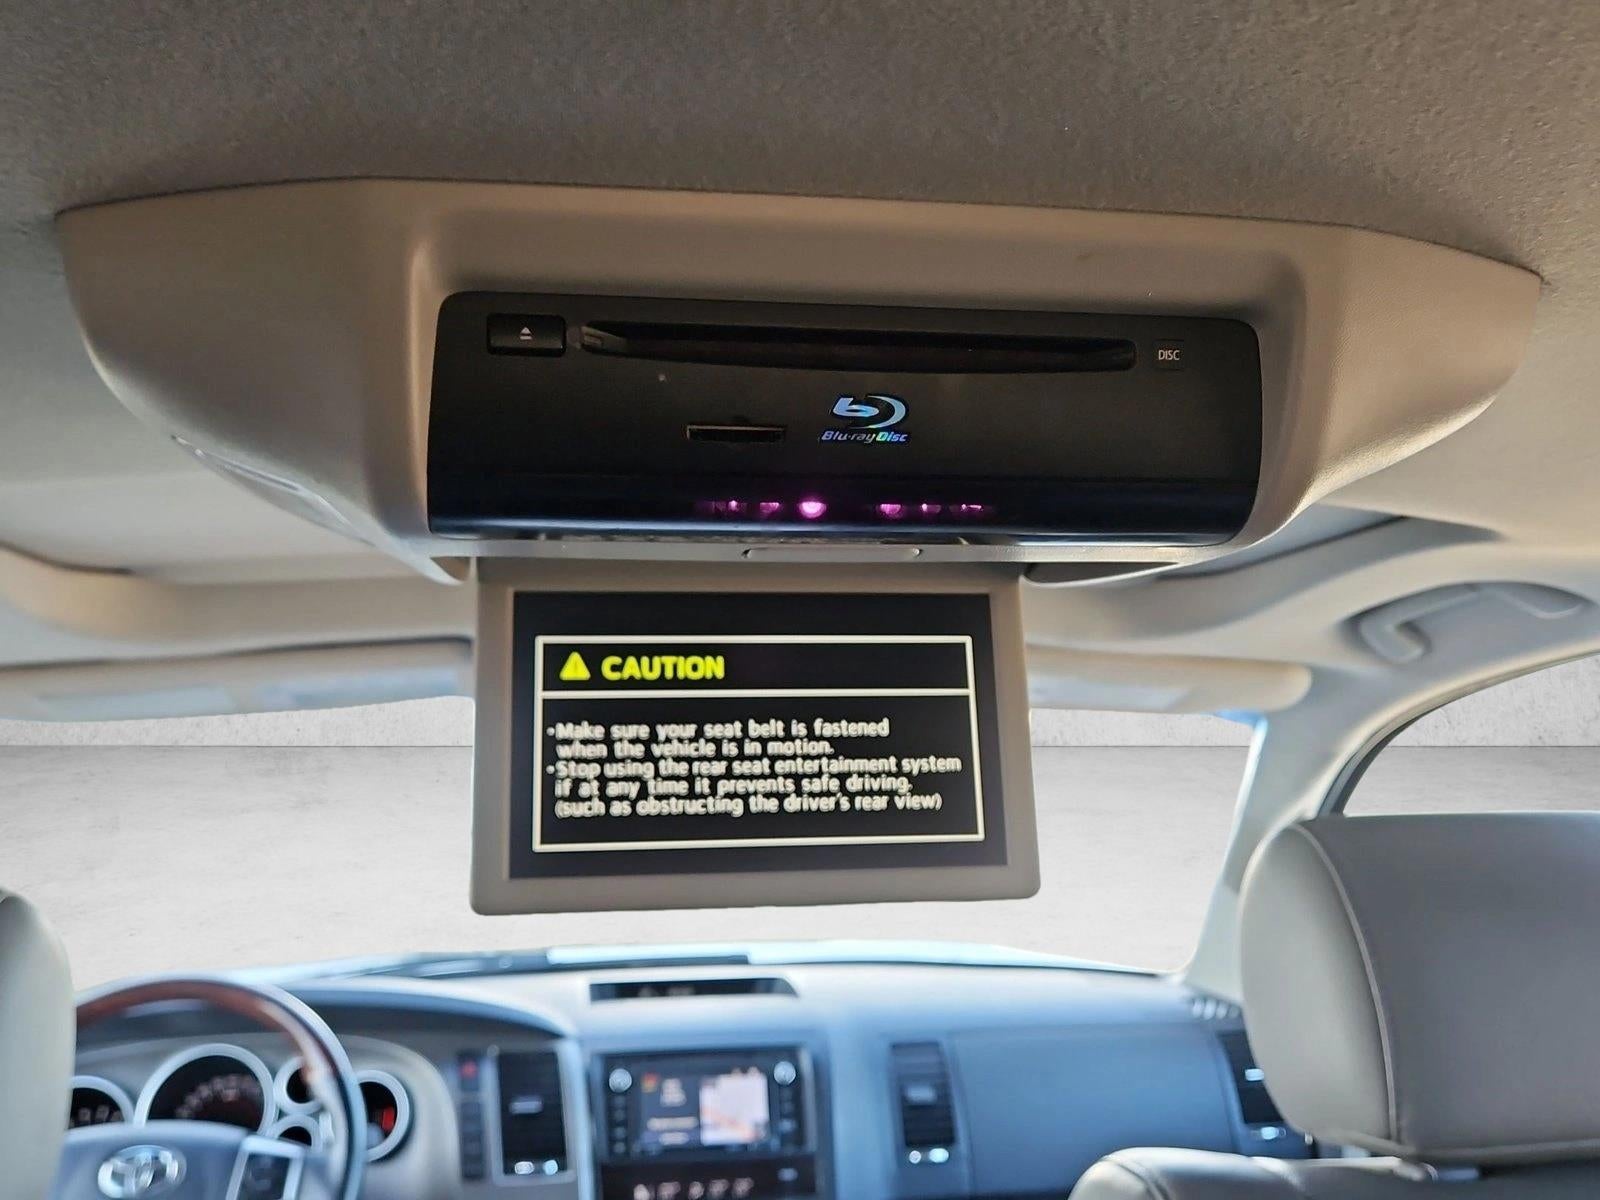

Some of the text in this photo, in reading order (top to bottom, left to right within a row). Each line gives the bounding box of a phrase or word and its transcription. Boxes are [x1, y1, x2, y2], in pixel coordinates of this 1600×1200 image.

[1158, 349, 1180, 361] DISC
[876, 431, 908, 442] Disc
[601, 655, 725, 681] CAUTION
[609, 723, 650, 741] sure
[655, 723, 698, 742] your
[703, 720, 743, 739] seat
[748, 717, 785, 738] belt
[791, 718, 808, 737] is
[813, 716, 890, 738] fastened
[555, 737, 835, 760] when the vehicle is in motion.
[603, 758, 655, 782] using
[658, 757, 690, 777] the
[692, 759, 729, 776] rear
[731, 757, 771, 776] seat
[774, 755, 899, 775] entertainment
[901, 755, 963, 777] system
[555, 773, 914, 801] if at any time it prevents safe driving.
[555, 792, 943, 820] (such as obstructing the driver's rear view)
